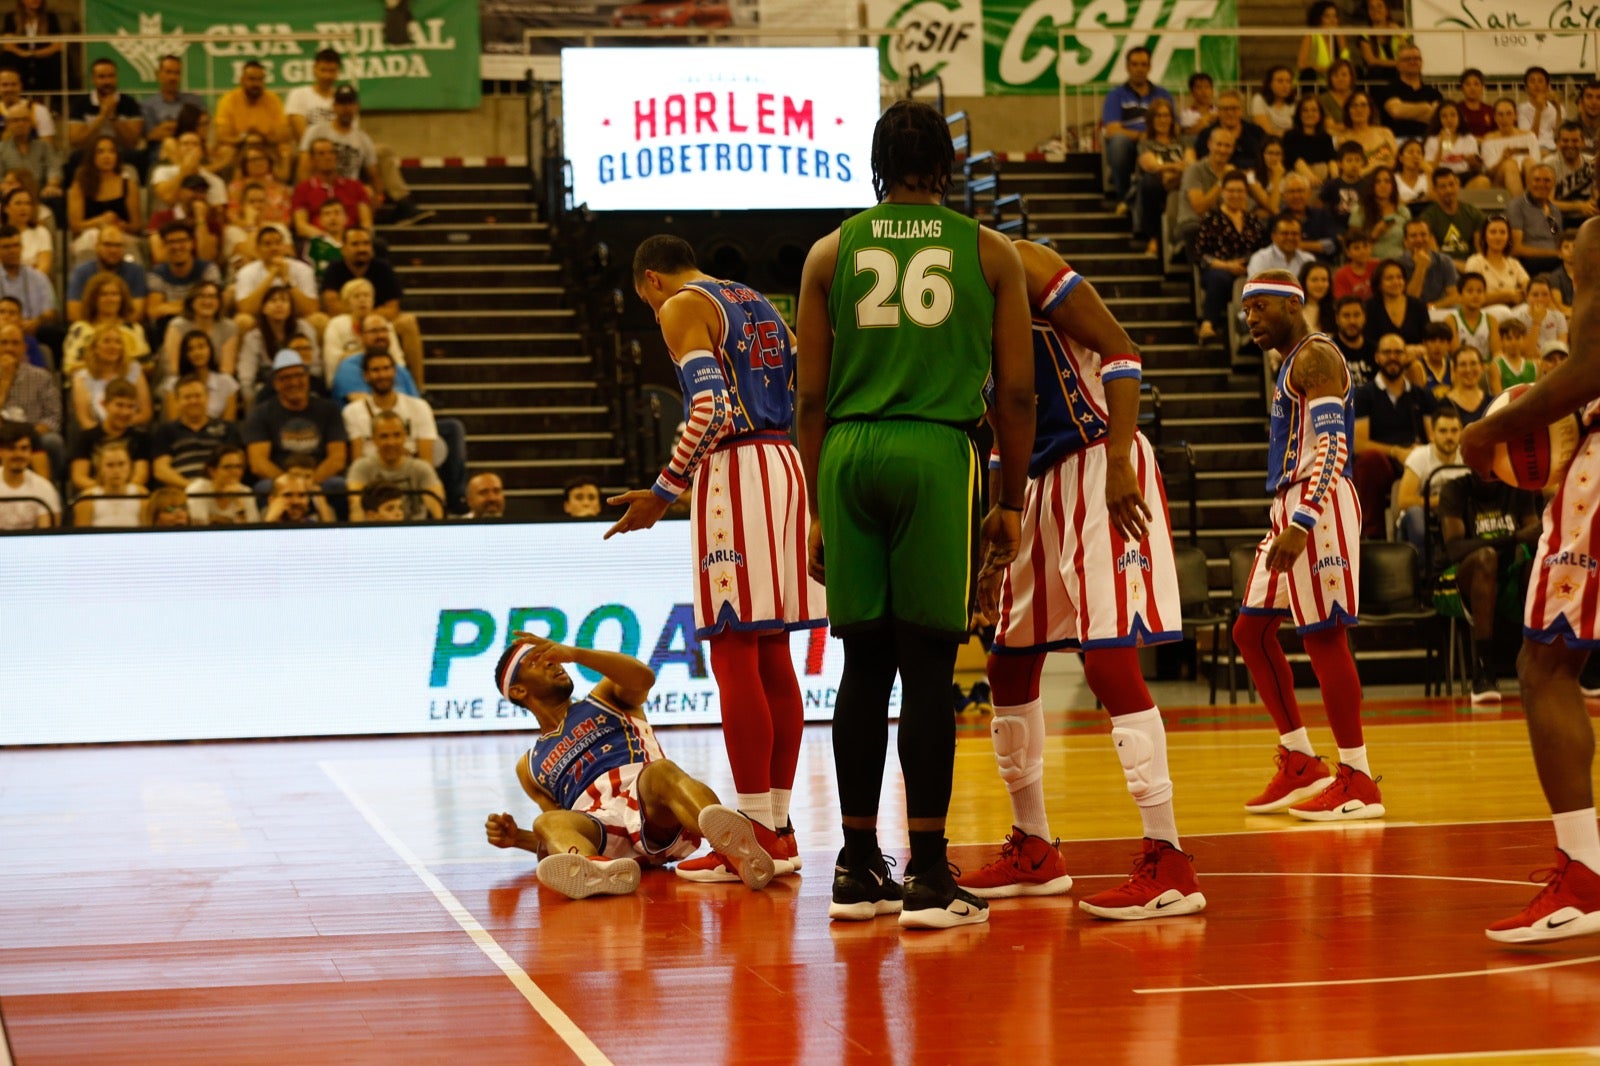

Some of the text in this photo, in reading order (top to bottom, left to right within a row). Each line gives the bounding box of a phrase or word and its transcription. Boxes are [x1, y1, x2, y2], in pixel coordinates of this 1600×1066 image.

[203, 19, 456, 57] CAJA RUAL
[895, 20, 976, 55] CSIF
[998, 0, 1218, 86] CSIF
[282, 54, 431, 84] GNADA
[634, 91, 814, 141] HARLEM
[599, 142, 852, 184] GLOBETROTTERS
[871, 219, 942, 239] WILLIAMS
[854, 246, 954, 329] 26
[702, 549, 743, 573] HARLEM
[1312, 556, 1349, 576] HARLEM
[429, 699, 484, 720] LIVE
[540, 717, 598, 775] HARLEM
[567, 750, 597, 784] 71
